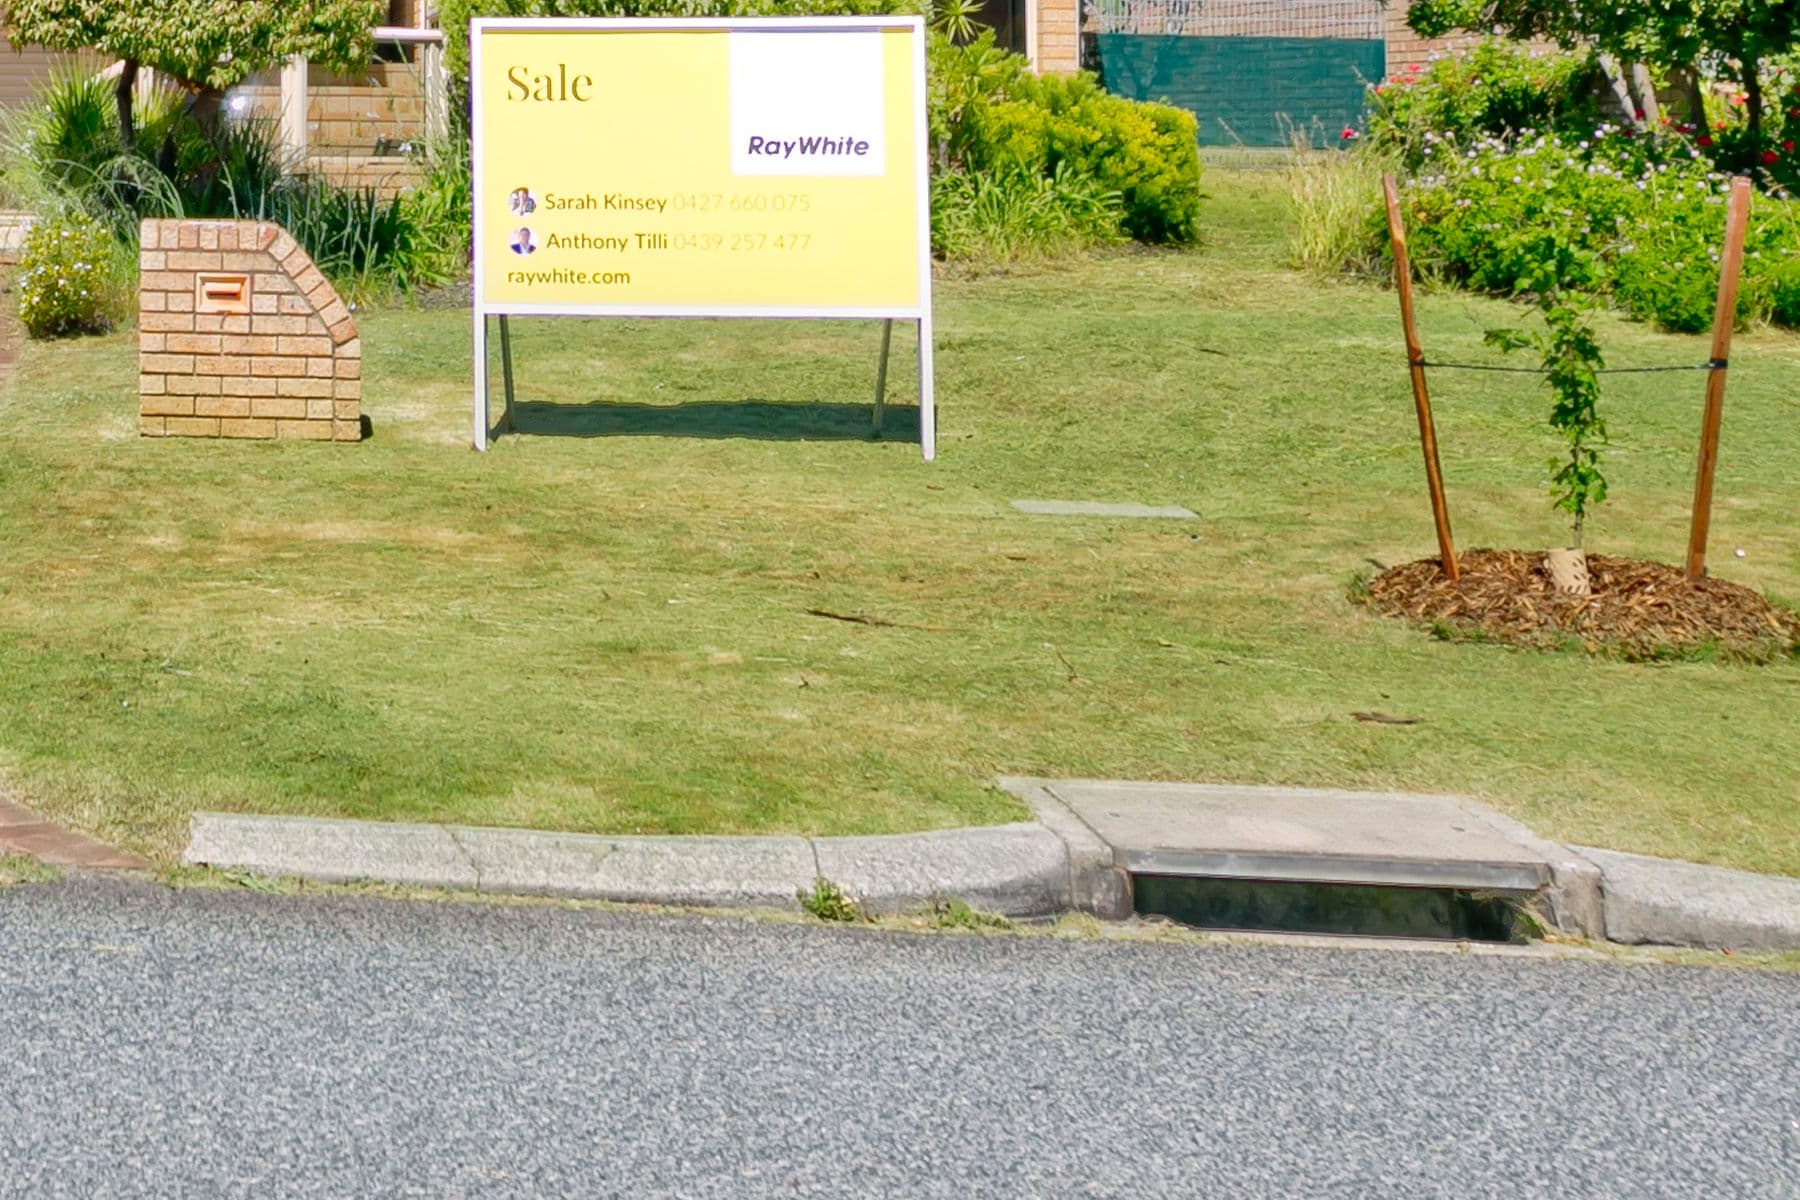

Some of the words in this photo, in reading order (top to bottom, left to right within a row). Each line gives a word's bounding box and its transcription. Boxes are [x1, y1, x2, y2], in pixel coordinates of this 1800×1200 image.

[507, 63, 593, 102] Sale
[545, 193, 598, 210] Sarah
[604, 193, 667, 213] Kinsey
[672, 193, 723, 211] 0427
[730, 193, 768, 211] 660
[772, 193, 811, 211] 075
[546, 233, 628, 252] Anthony
[634, 233, 668, 249] Tilli
[673, 233, 723, 250] 0439
[730, 233, 768, 251] 257
[773, 233, 812, 251] 477
[508, 268, 631, 286] raywhite.com
